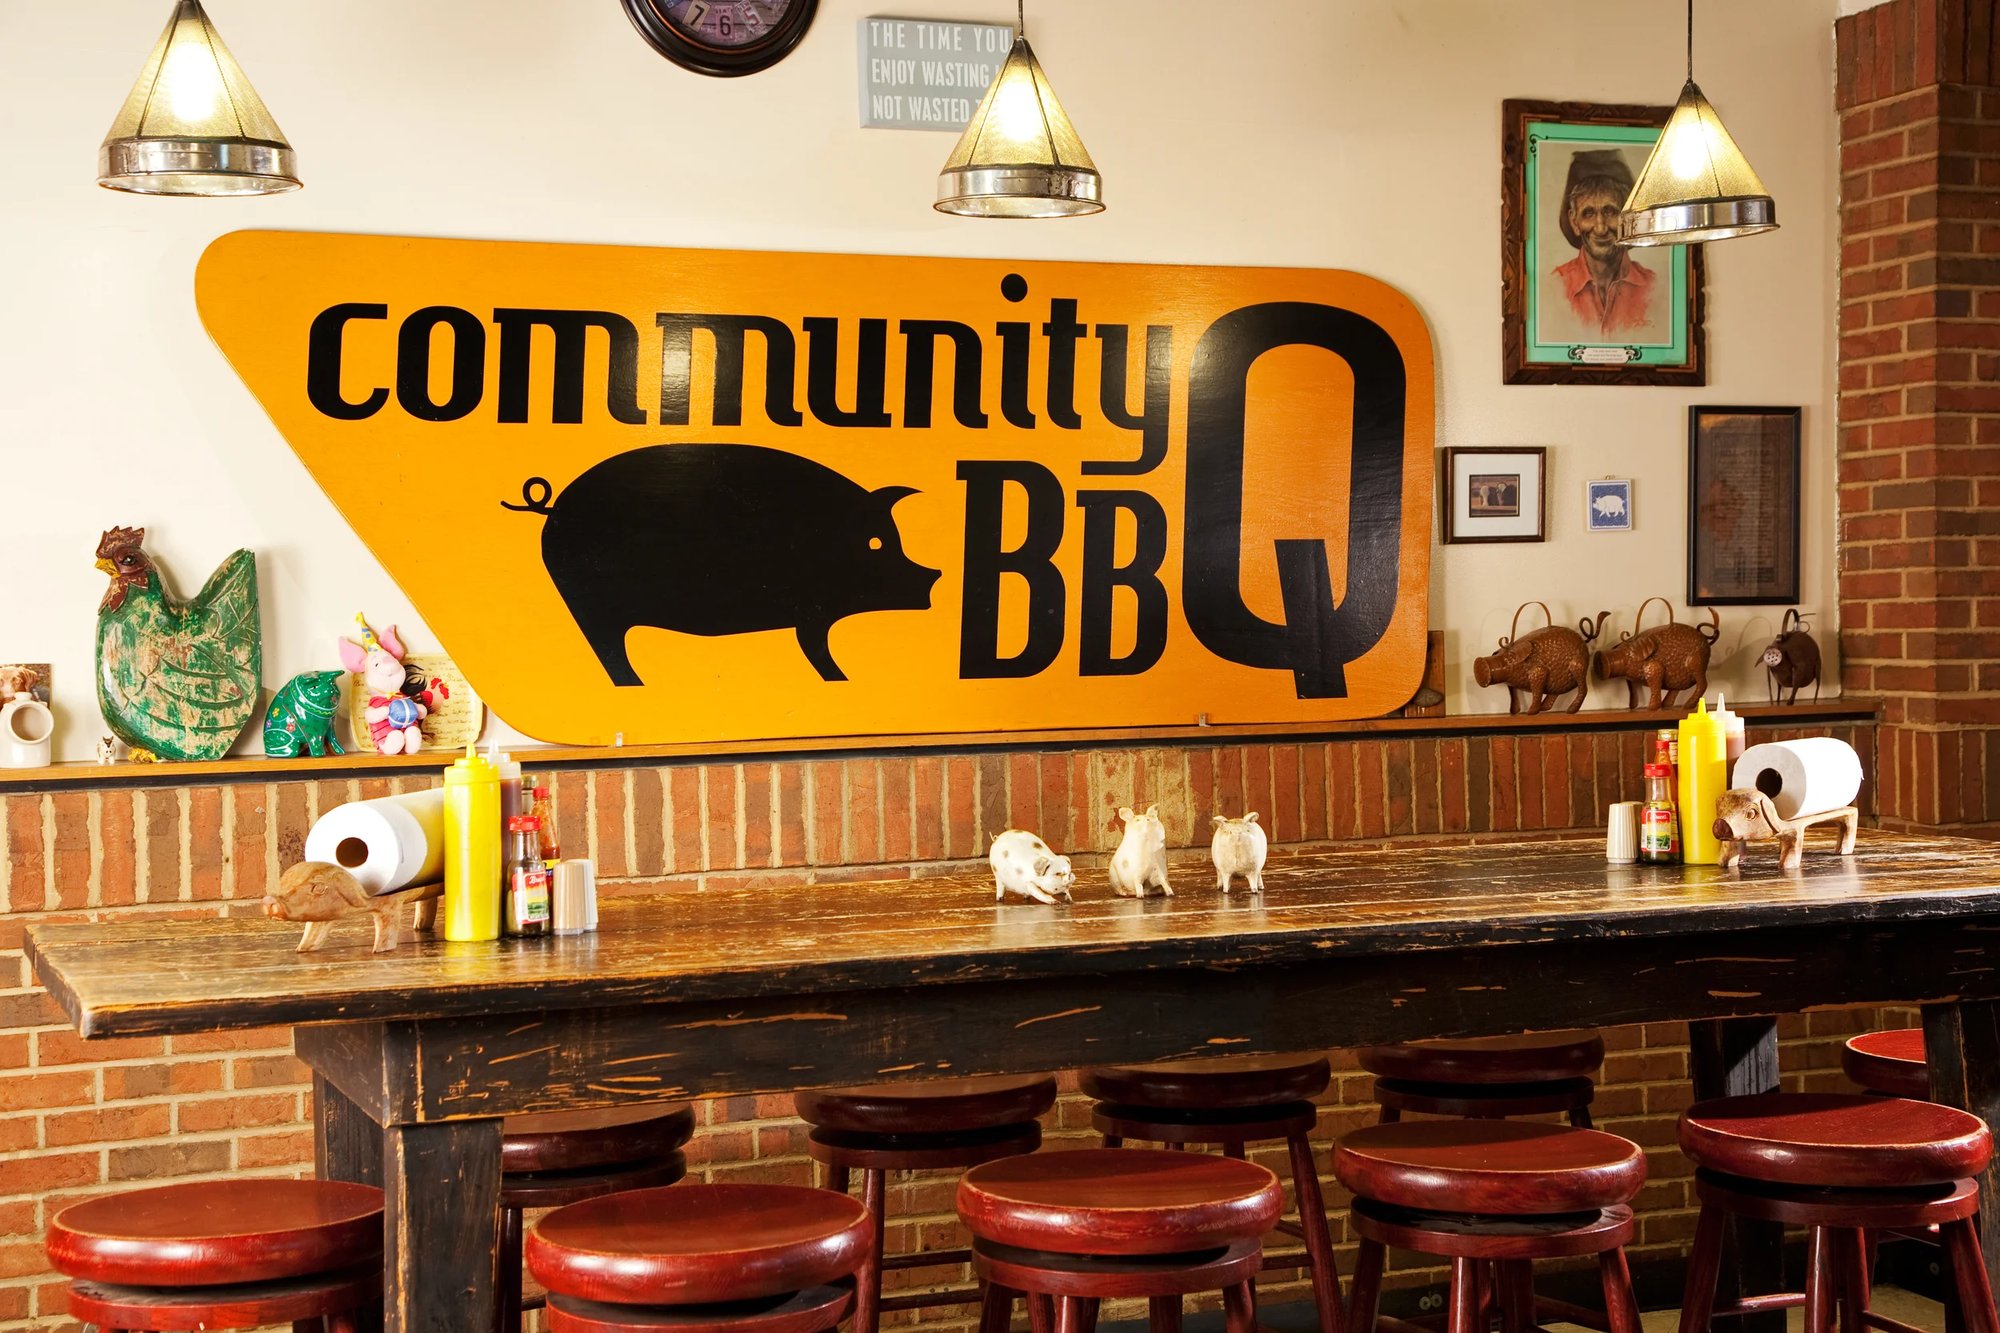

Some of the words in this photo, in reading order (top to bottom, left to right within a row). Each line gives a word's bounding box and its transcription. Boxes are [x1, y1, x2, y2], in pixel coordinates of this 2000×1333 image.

[690, 4, 705, 26] 7
[719, 15, 732, 36] 6
[742, 7, 760, 26] 5
[870, 22, 906, 48] THE
[917, 25, 962, 51] TIME
[974, 28, 1009, 53] YOU
[871, 58, 916, 86] ENJOY
[921, 61, 990, 88] WASTING
[873, 95, 902, 120] NOT
[908, 96, 970, 123] WASTED
[306, 273, 1173, 475] community
[956, 301, 1407, 699] BBQ
